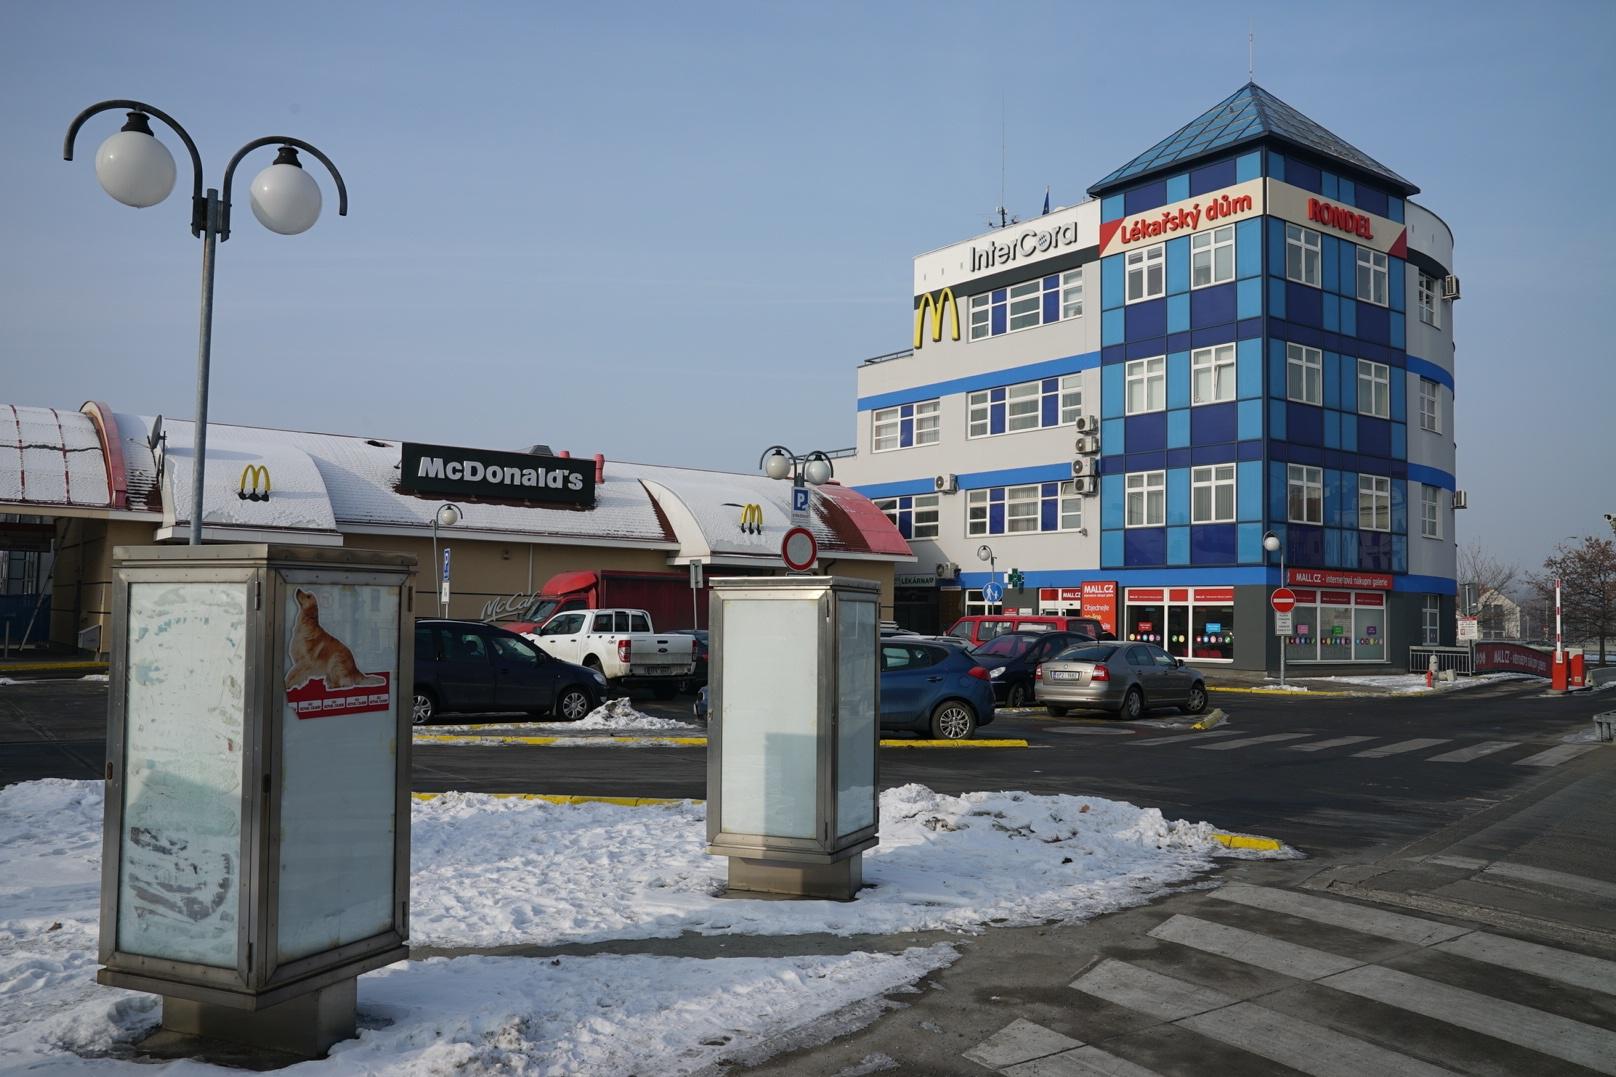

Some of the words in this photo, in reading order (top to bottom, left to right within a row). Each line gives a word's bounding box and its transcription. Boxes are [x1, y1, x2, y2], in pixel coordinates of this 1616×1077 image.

[1121, 203, 1201, 245] Lékařský
[1206, 193, 1253, 221] dům
[1308, 197, 1374, 240] RONDEL
[969, 220, 1078, 272] InterCora
[417, 456, 584, 491] McDonald's
[1084, 585, 1114, 593] MALL.CZ
[1296, 573, 1321, 583] MALL.CZ
[480, 591, 541, 622] McCaf
